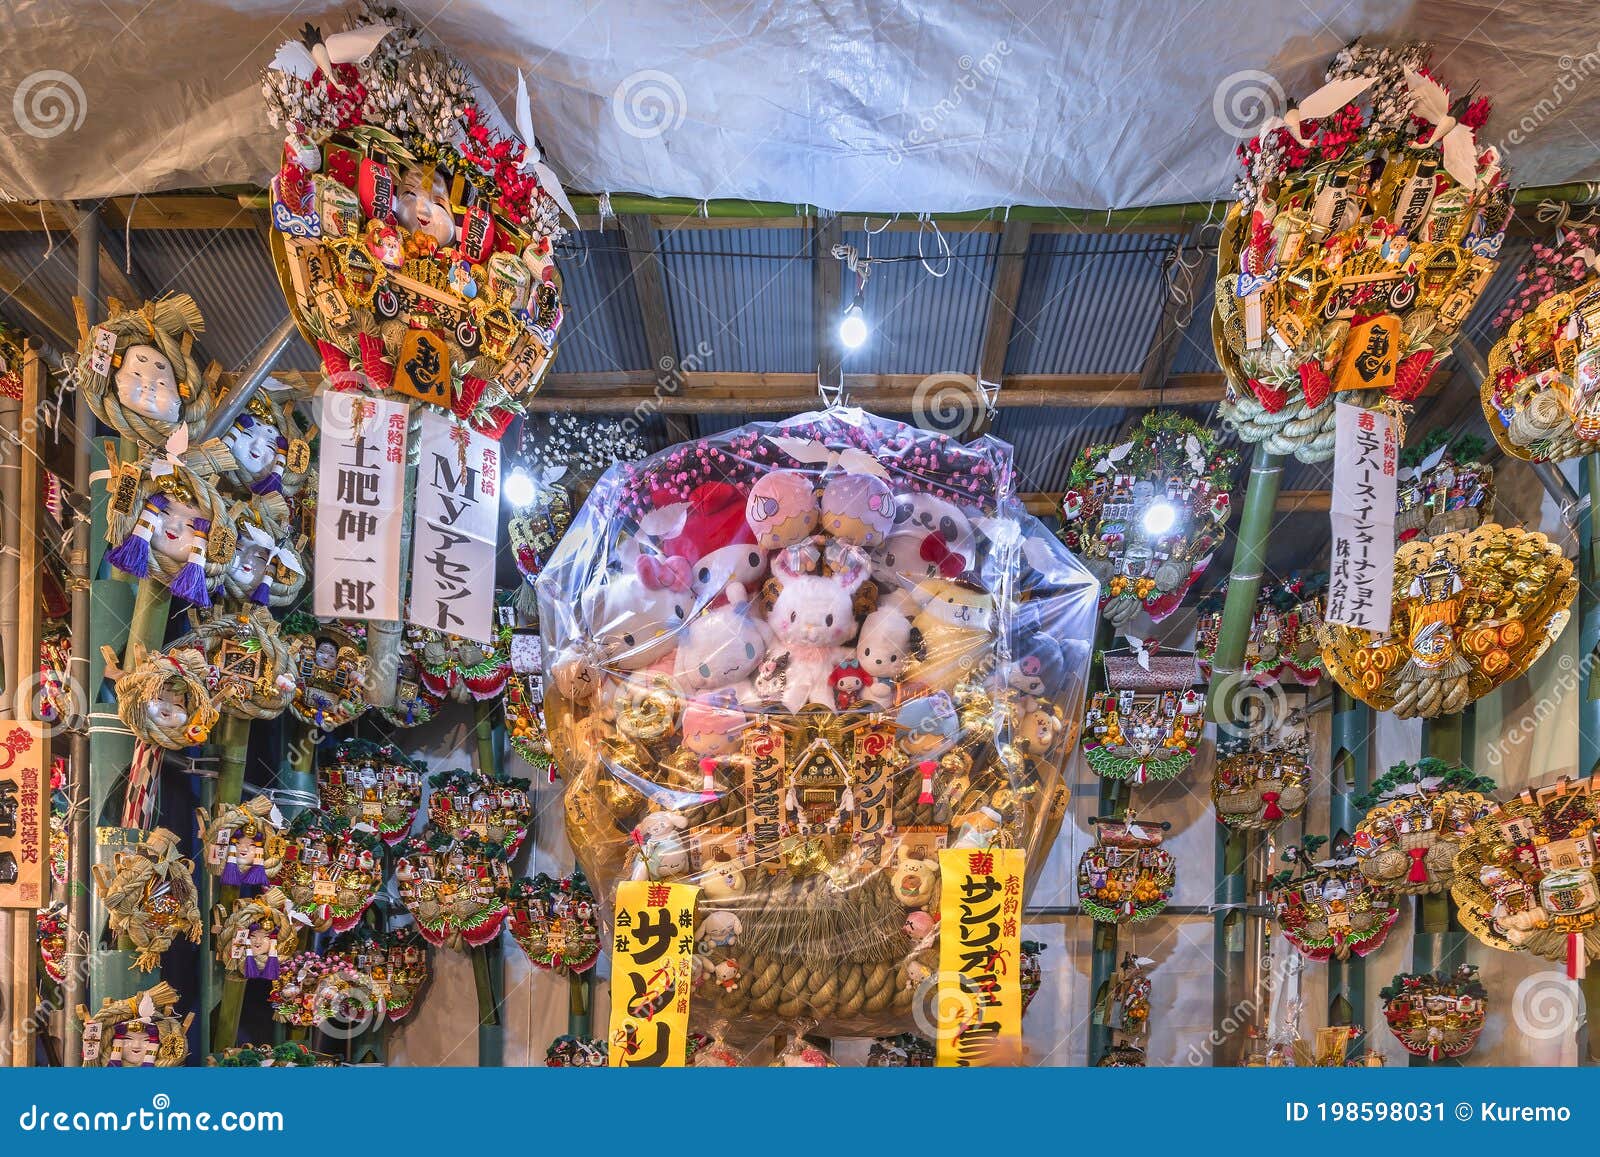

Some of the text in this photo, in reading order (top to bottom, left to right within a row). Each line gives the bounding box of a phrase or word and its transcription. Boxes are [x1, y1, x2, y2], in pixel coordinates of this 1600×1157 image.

[386, 413, 405, 464] 売約済
[480, 447, 497, 498] 売約済
[333, 436, 381, 614] 土肥伸一郎
[424, 452, 480, 630] Myアセット
[1329, 536, 1351, 621] 株式会社
[615, 907, 632, 953] 会社
[678, 908, 693, 955] 株式
[1003, 874, 1021, 939] 売約済
[676, 958, 690, 1014] 売約済
